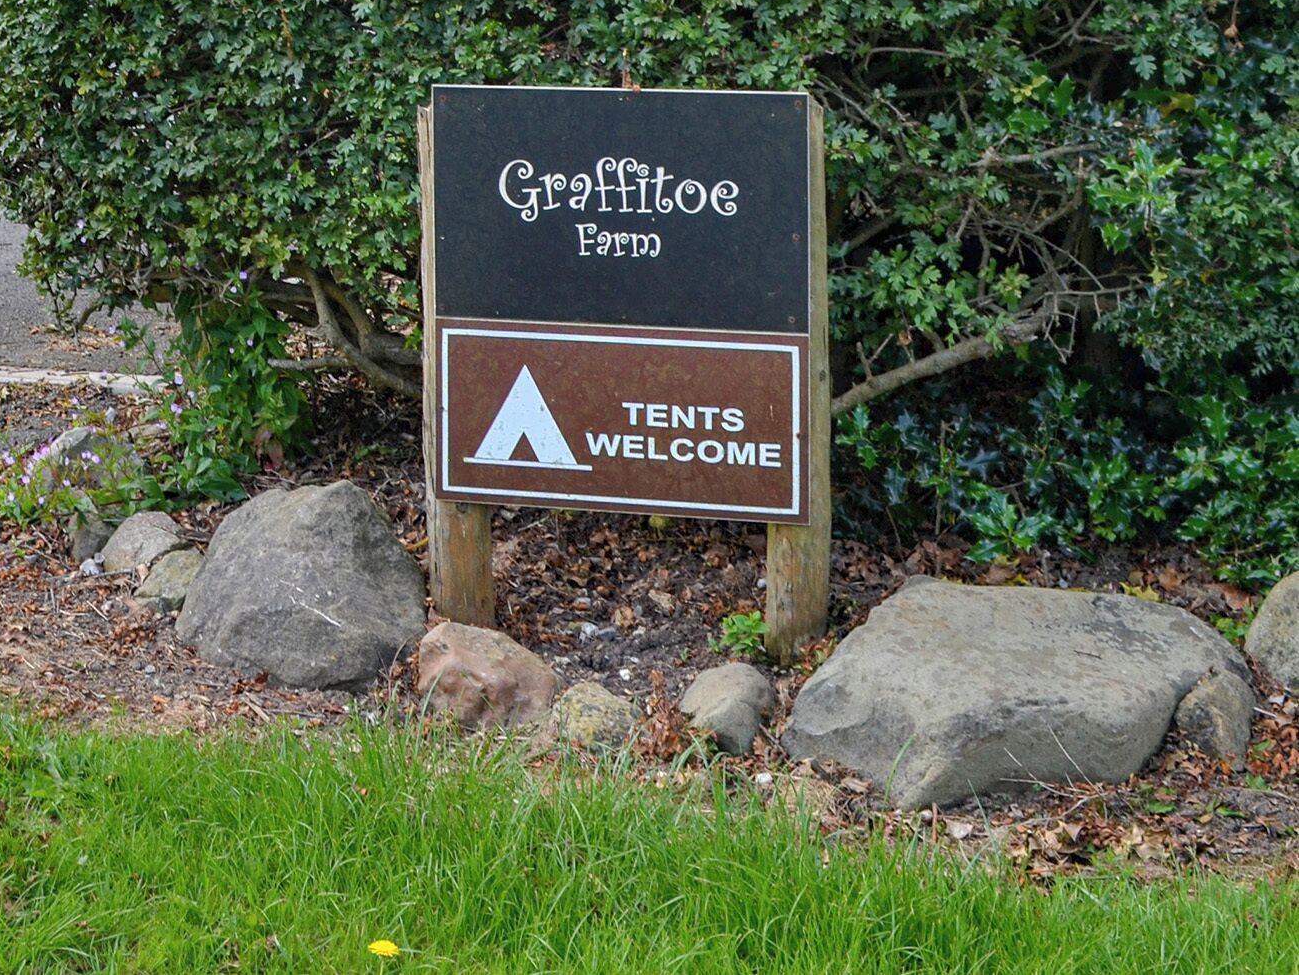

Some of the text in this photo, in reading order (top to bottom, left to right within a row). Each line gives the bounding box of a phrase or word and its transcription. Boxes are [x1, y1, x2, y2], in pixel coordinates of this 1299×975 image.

[498, 157, 739, 221] Graffitoe
[575, 223, 661, 258] Farm
[622, 402, 744, 432] TENTS
[586, 433, 781, 468] WELCOME
